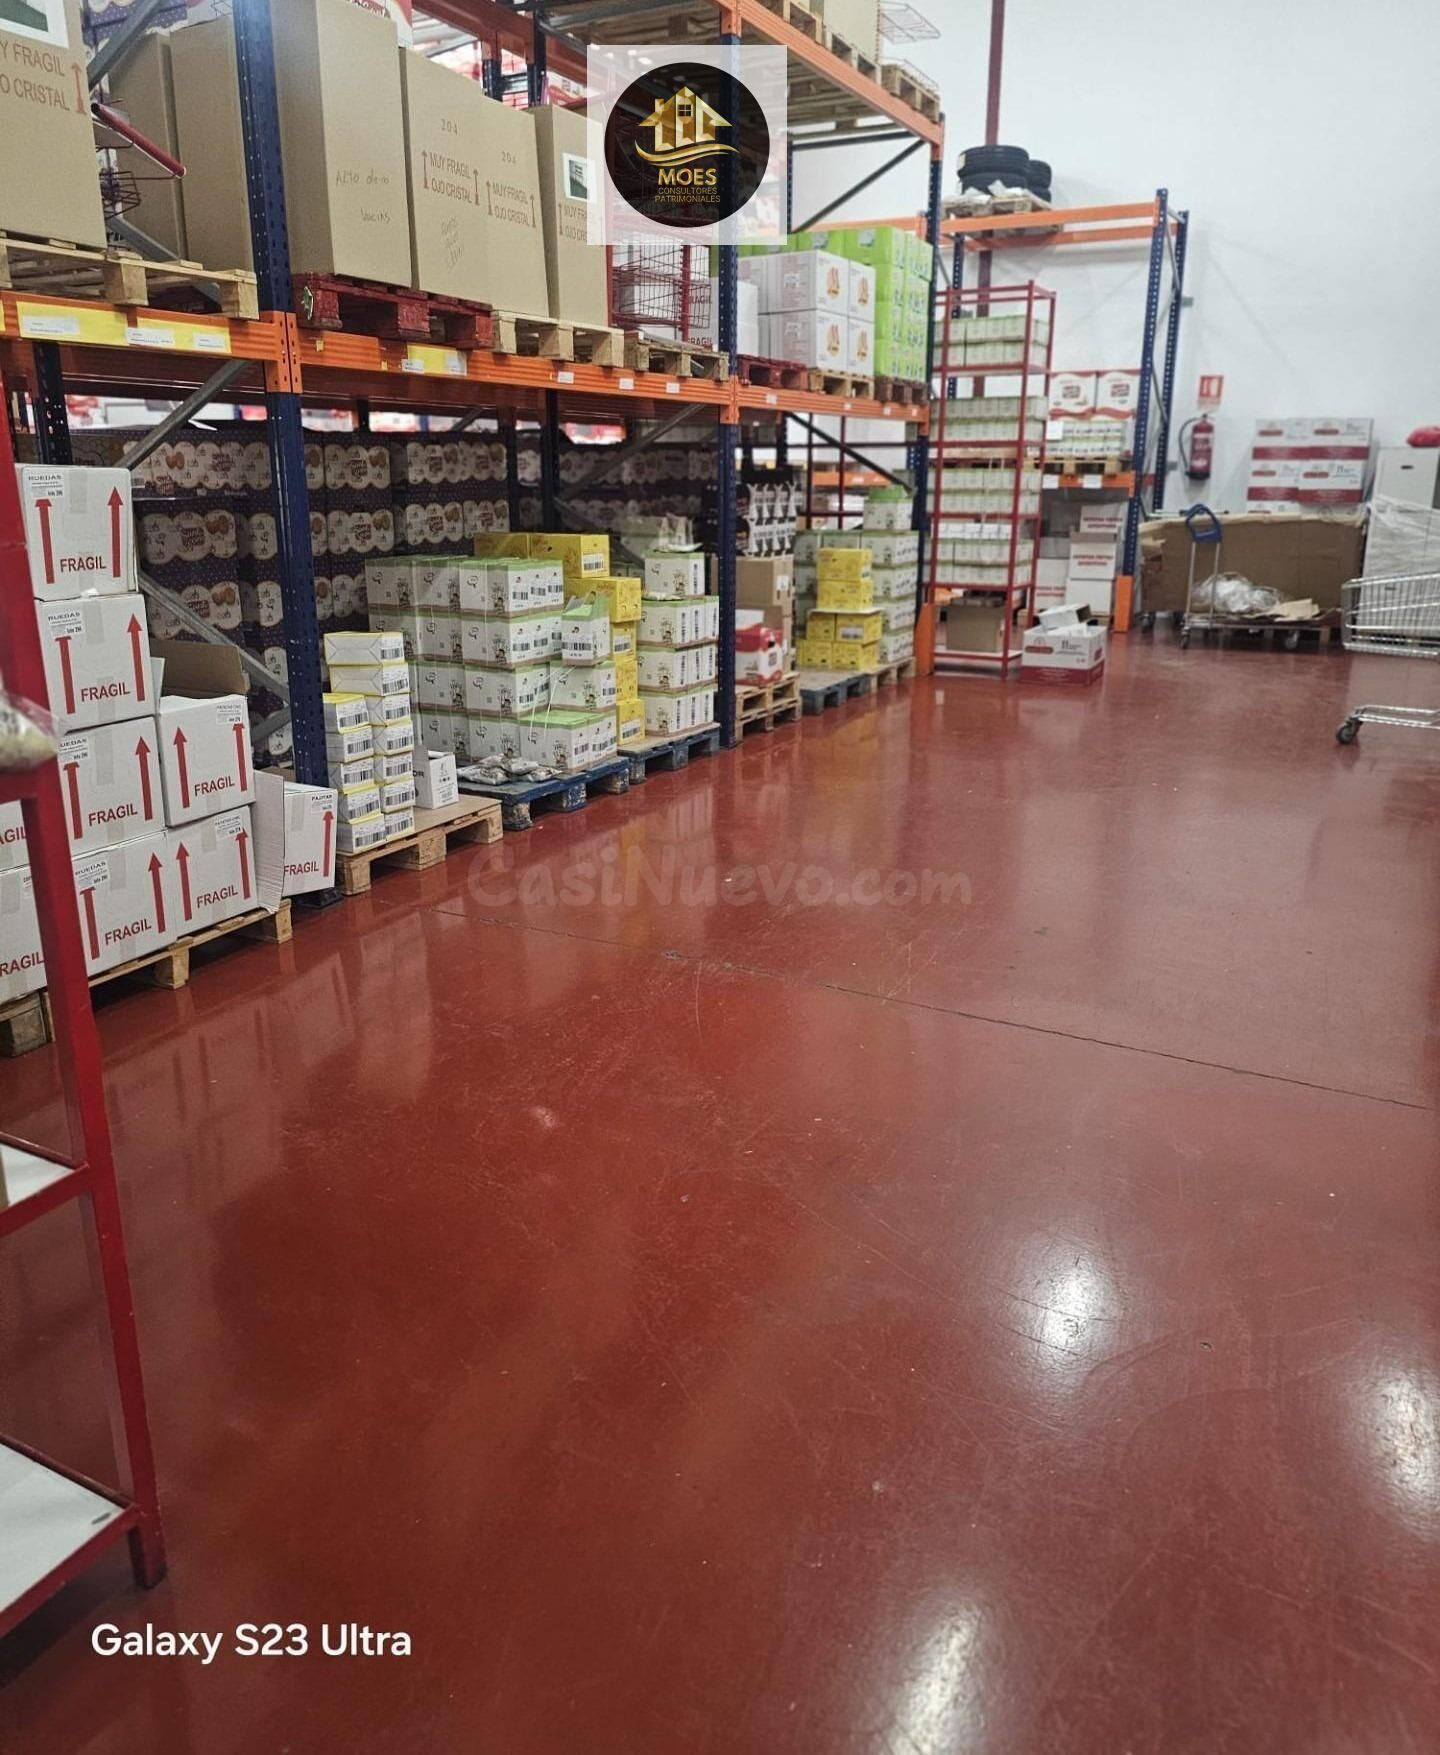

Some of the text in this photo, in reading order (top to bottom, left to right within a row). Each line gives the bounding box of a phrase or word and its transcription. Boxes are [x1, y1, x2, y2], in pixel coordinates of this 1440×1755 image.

[13, 43, 65, 76] FRAGIL
[13, 79, 70, 111] CRISTAL
[430, 152, 472, 179] MUY FRAGIL
[446, 182, 473, 204] CRISTAL
[59, 556, 106, 572] FRAGIL
[48, 611, 80, 621] RUEDAS
[81, 682, 130, 702] FRAGIL
[59, 738, 88, 748] UEDAS
[194, 776, 235, 797] FRAGIL
[88, 804, 138, 827] FRAGIL
[284, 861, 319, 877] FRAGIL
[197, 885, 238, 909] FRAGIL
[104, 919, 152, 946] FRAGIL
